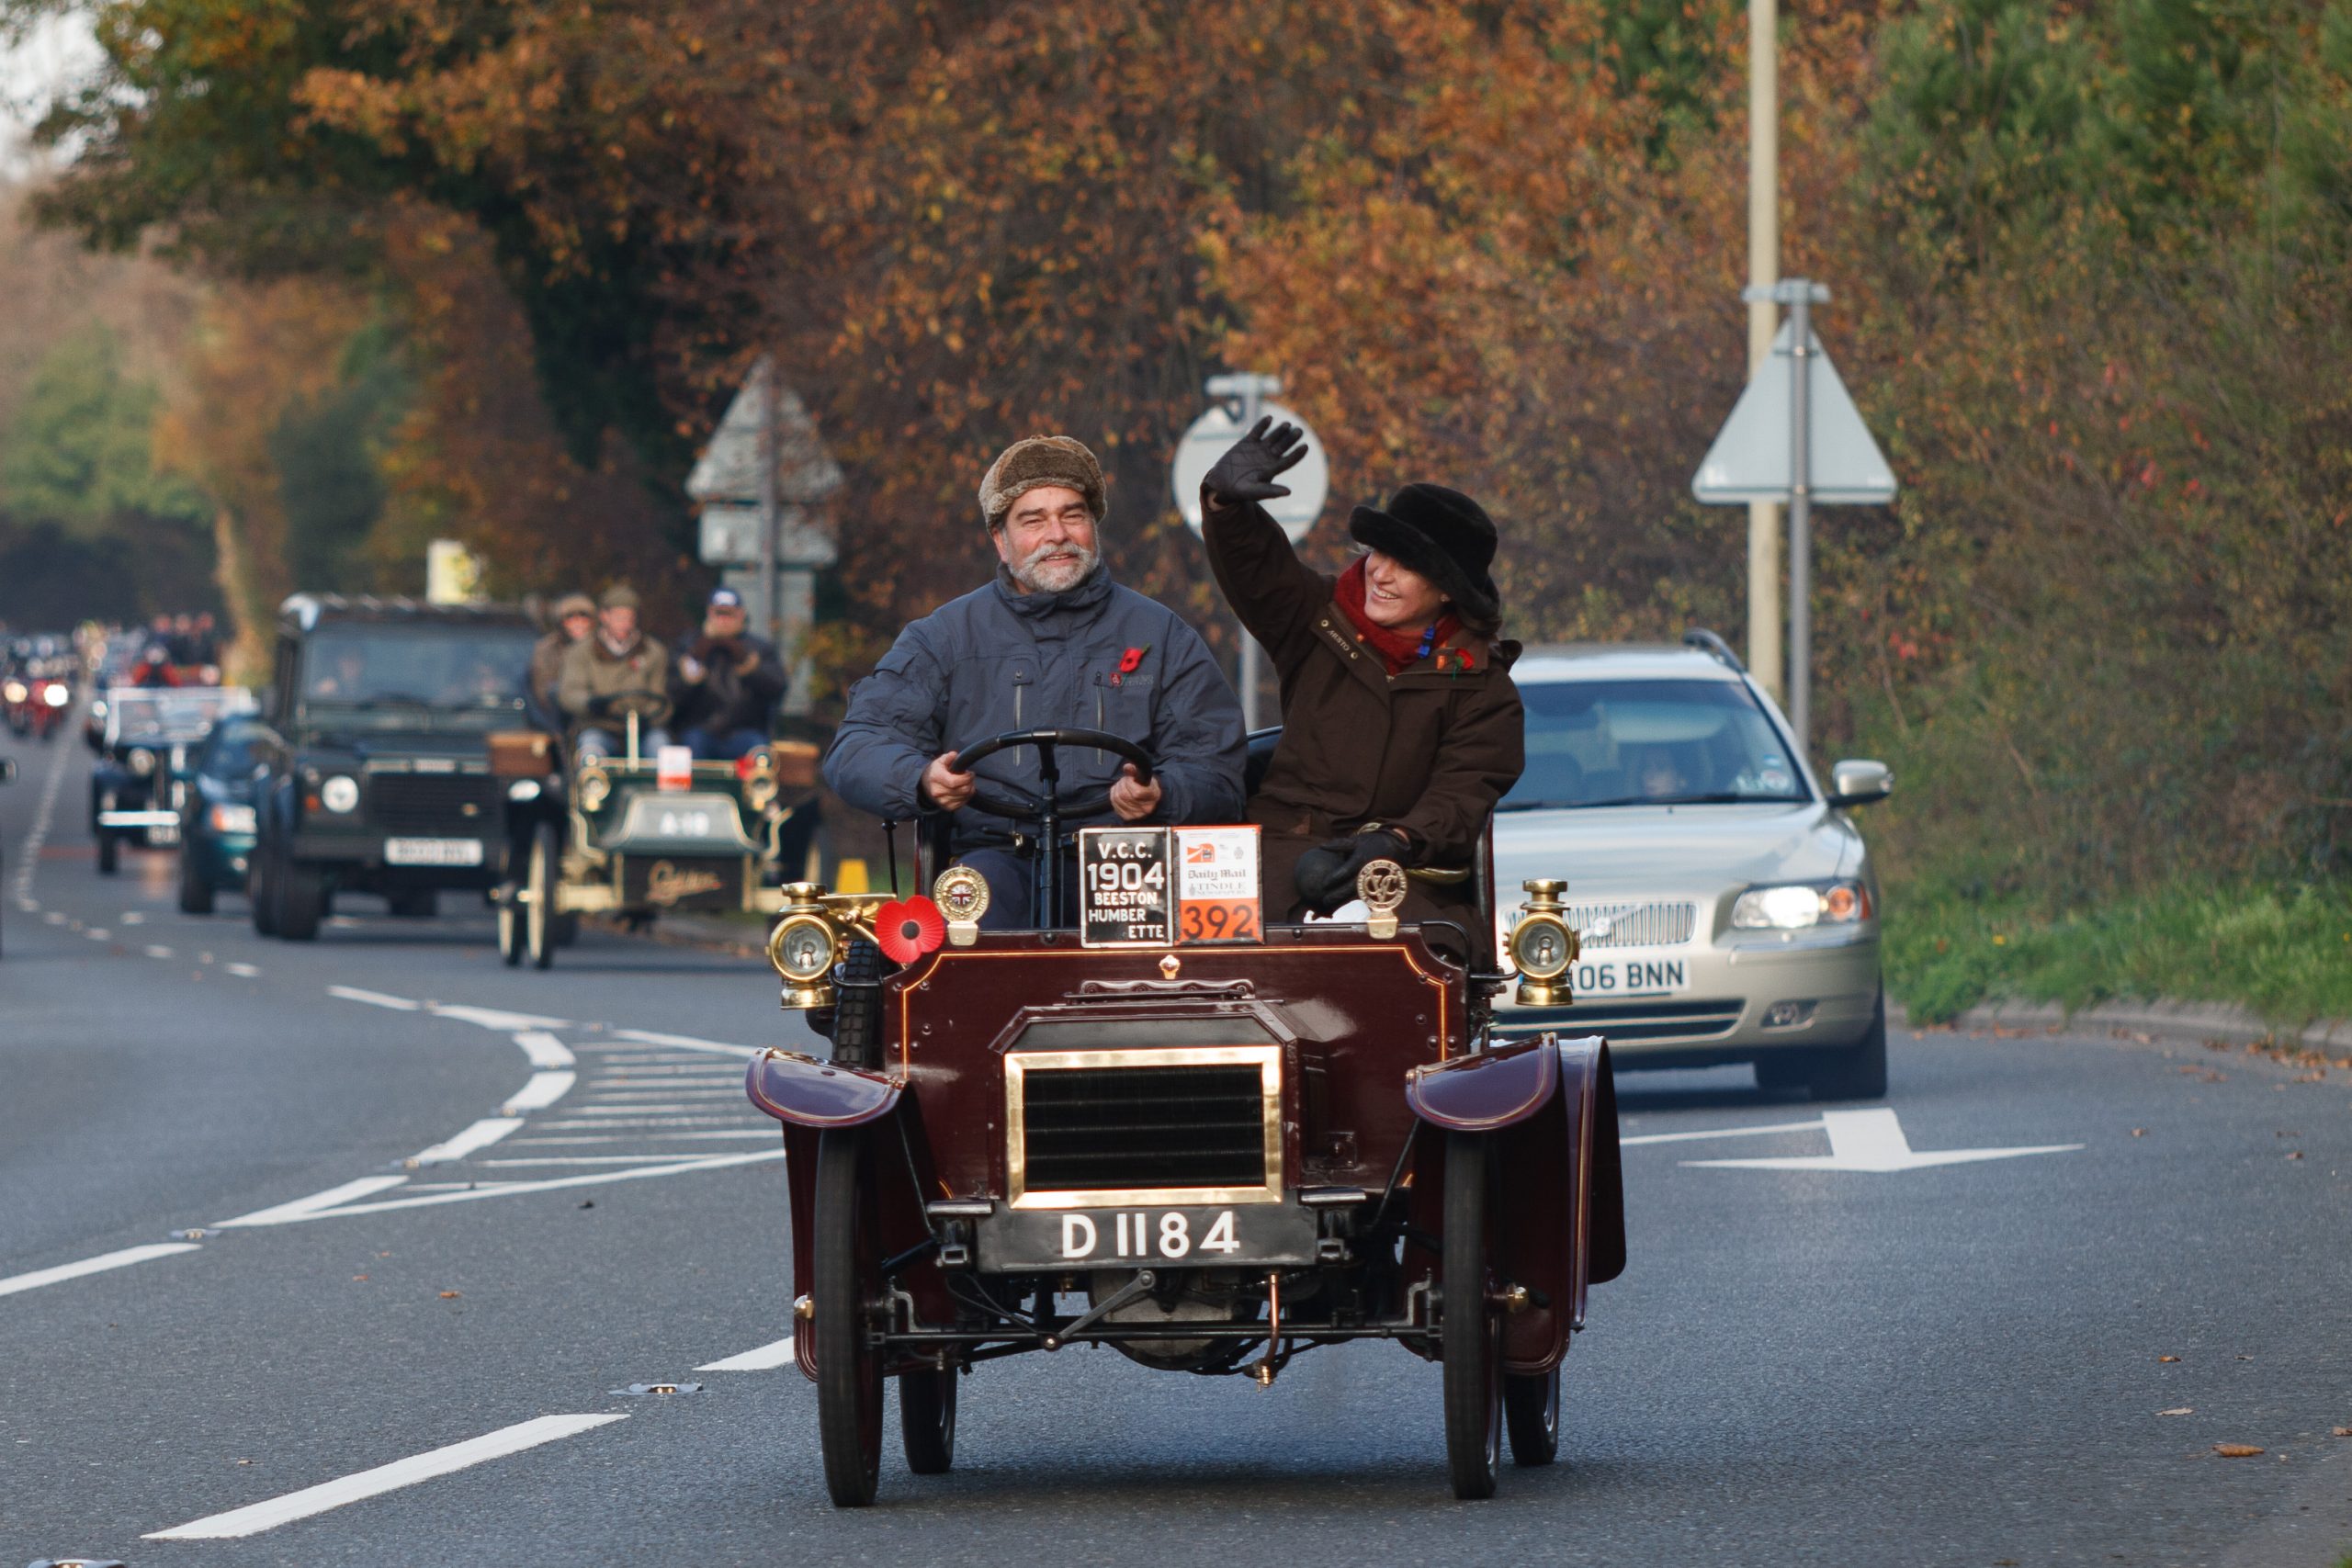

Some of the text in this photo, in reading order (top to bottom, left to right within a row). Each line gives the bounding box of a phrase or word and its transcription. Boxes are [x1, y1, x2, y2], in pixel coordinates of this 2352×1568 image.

[1098, 842, 1152, 859] V.C.C.
[1087, 862, 1165, 891] 1904
[1188, 869, 1246, 881] Daily Mail
[1094, 892, 1158, 906] BEESTON
[1088, 908, 1147, 922] HUMBER
[1183, 904, 1253, 939] 392
[1128, 924, 1164, 939] ETTE
[1627, 960, 1683, 987] BNN
[1061, 1211, 1240, 1258] D 1184
